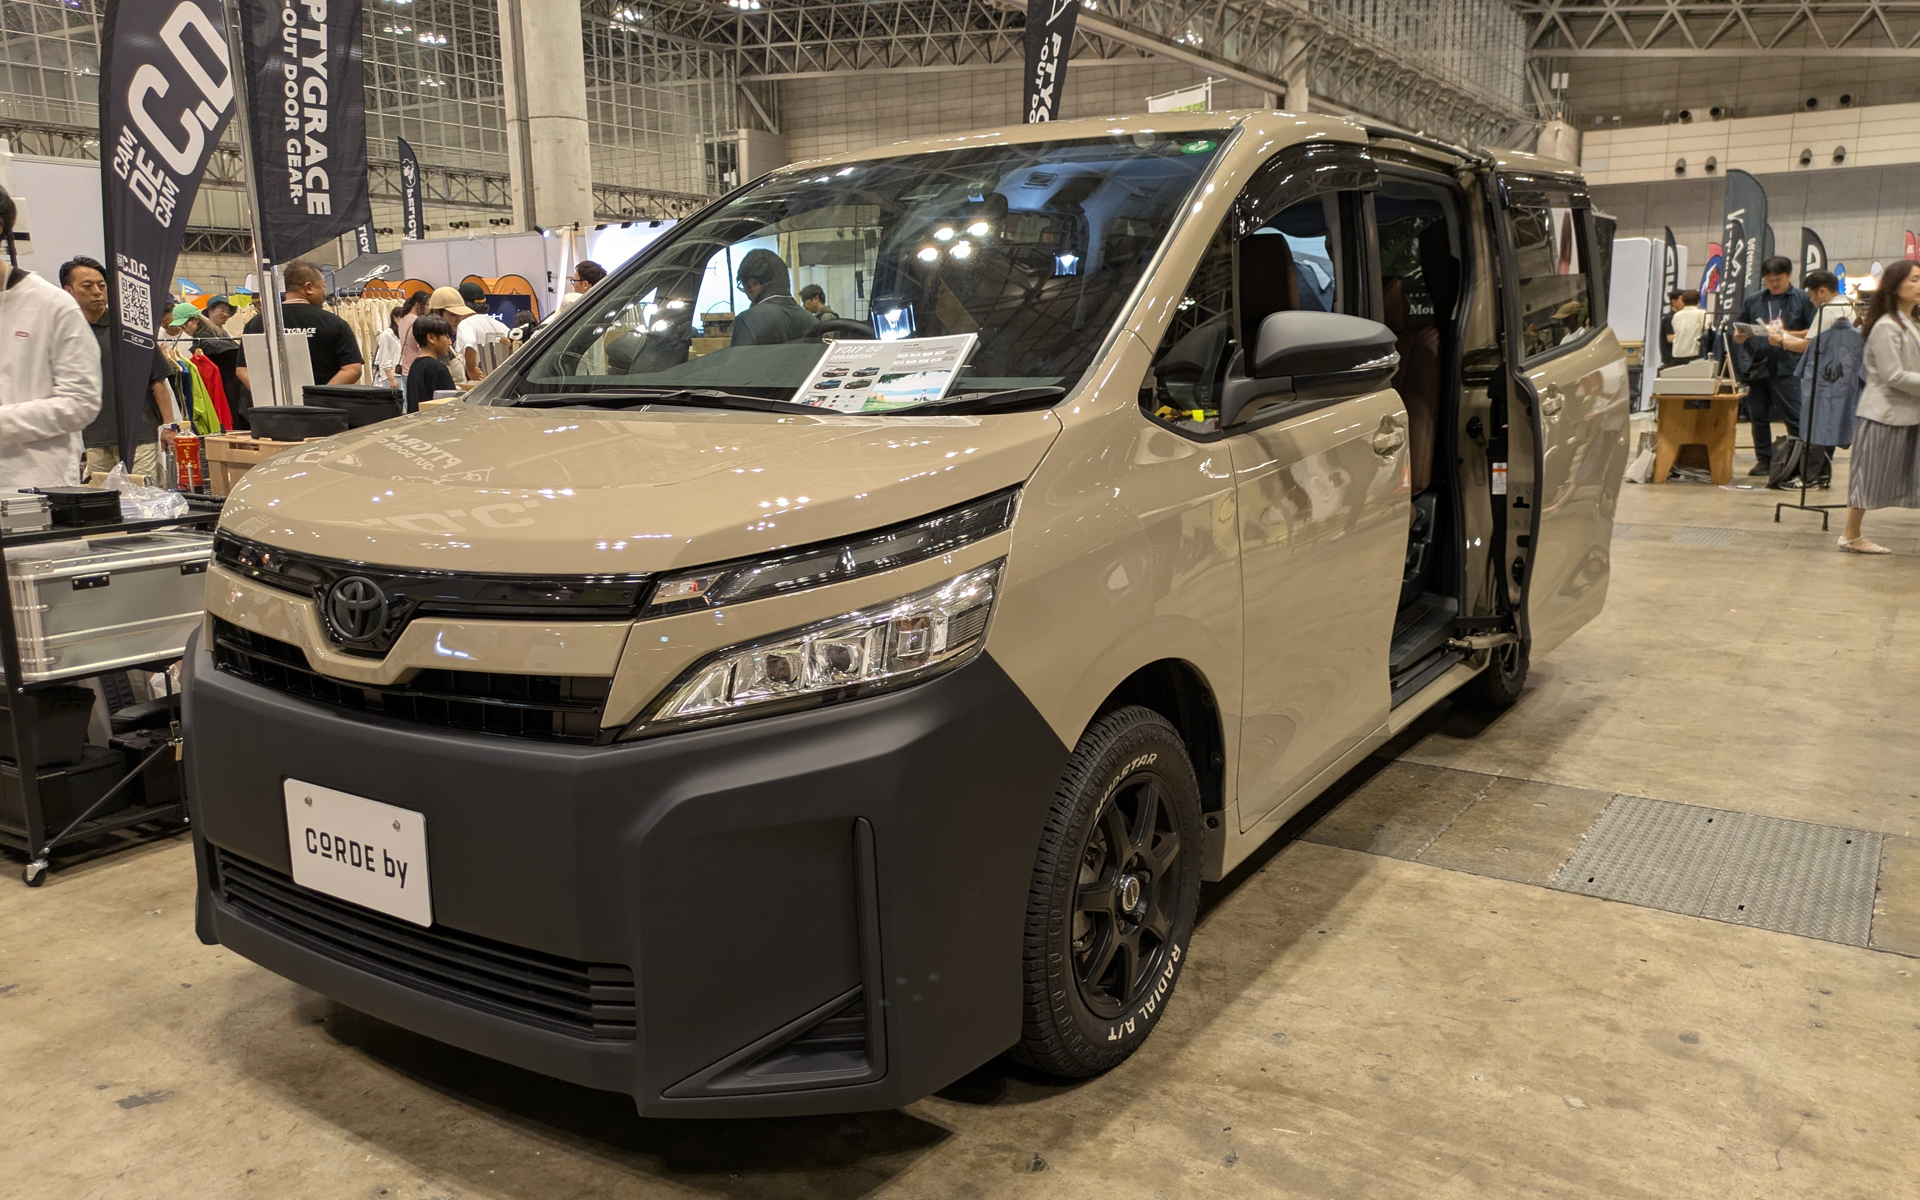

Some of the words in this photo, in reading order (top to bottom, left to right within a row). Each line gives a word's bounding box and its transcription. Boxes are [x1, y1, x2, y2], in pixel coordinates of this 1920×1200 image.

[1035, 37, 1049, 89] -OUT
[284, 63, 300, 131] DOOR
[301, 0, 332, 215] PTYGRACE
[113, 125, 139, 180] CAM
[129, 146, 165, 213] DE
[286, 138, 304, 205] GEAR-
[155, 176, 180, 228] CAM
[122, 255, 150, 282] C.D.C.
[383, 848, 408, 889] by
[1138, 943, 1182, 1020] RADIAL
[1107, 1016, 1136, 1041] A/T
